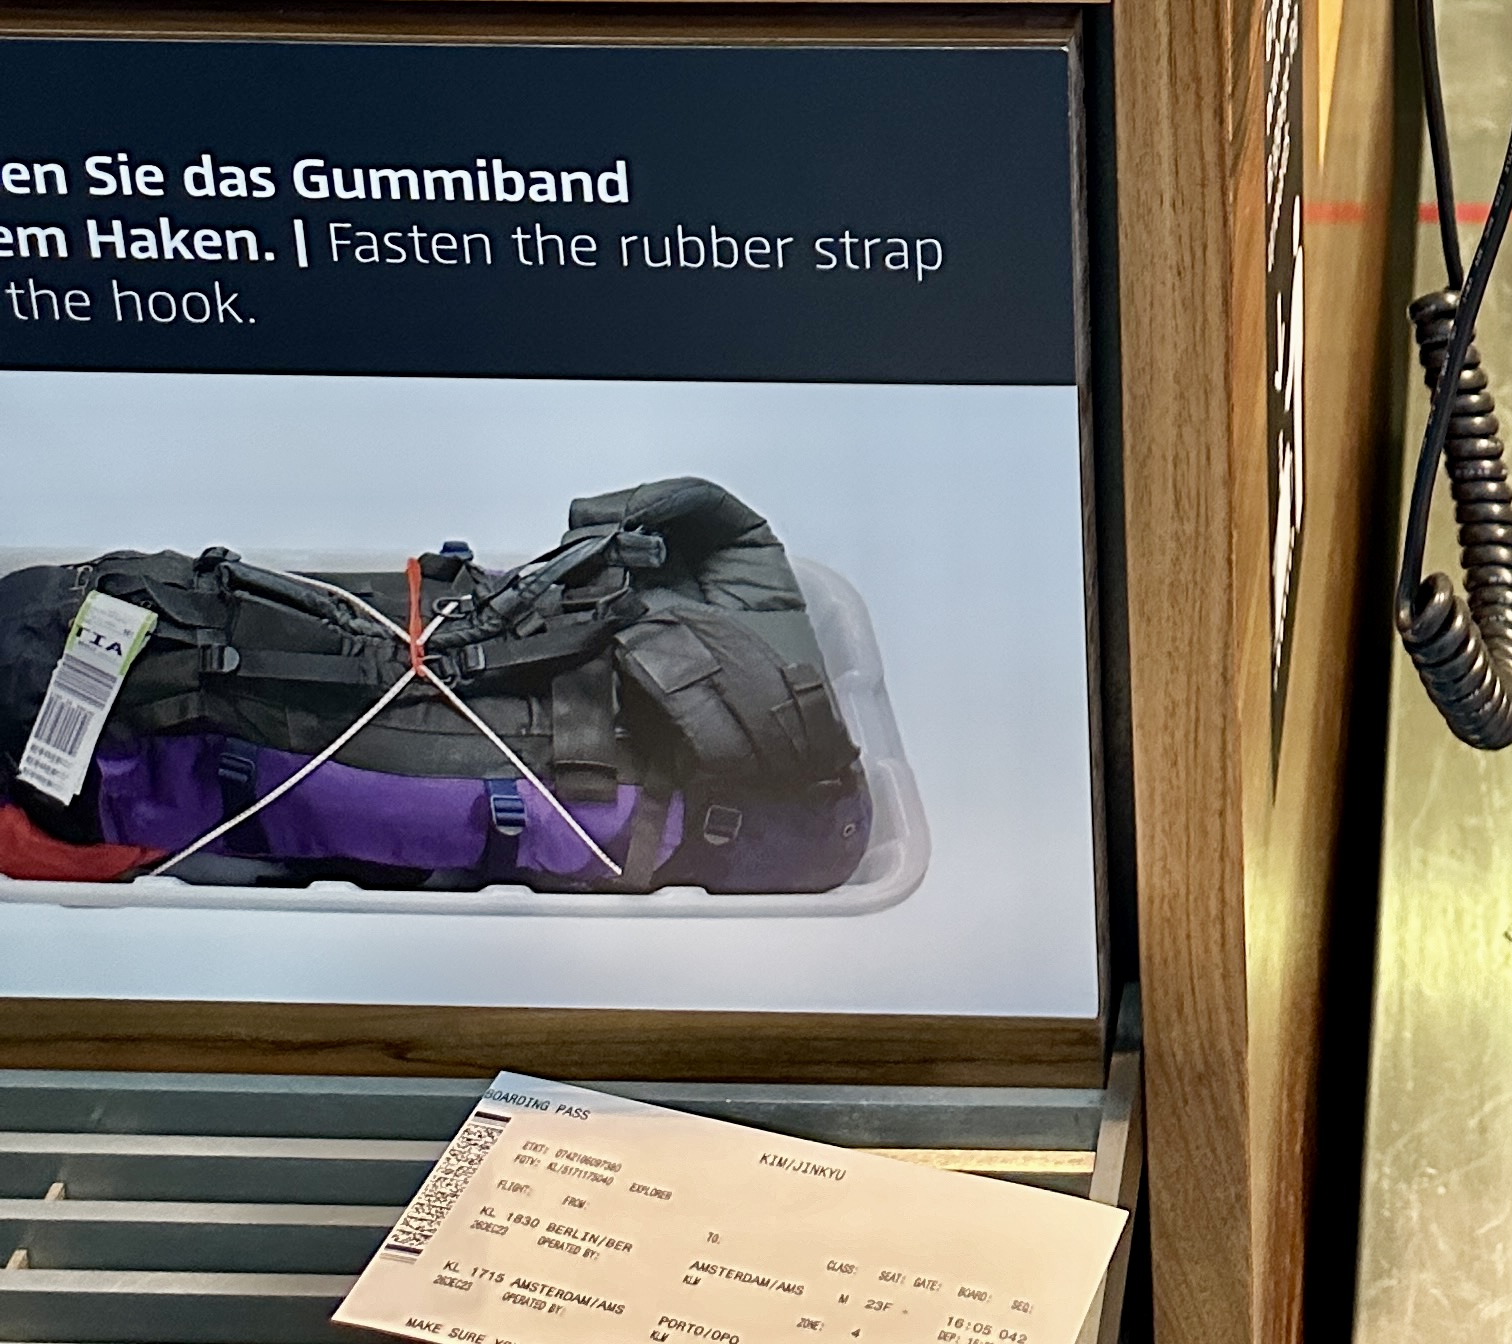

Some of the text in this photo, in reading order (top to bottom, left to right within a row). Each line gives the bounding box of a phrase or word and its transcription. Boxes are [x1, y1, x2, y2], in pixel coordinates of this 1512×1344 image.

[2, 153, 630, 205] en Sie das Gummiband
[86, 217, 275, 261] Haken.
[331, 221, 492, 267] Fasten
[513, 222, 597, 268] the
[620, 225, 793, 272] rubber
[813, 231, 943, 282] strap
[5, 278, 255, 324] the hook.
[483, 1089, 591, 1120] BOARDING PASS
[759, 1153, 847, 1181] KIM/JINKYU
[480, 1206, 496, 1218] KL
[507, 1212, 540, 1229] 1830
[545, 1222, 633, 1253] BERLIN/BER
[689, 1261, 805, 1296] AMSTERDAM/AMS
[838, 1294, 849, 1305] M
[947, 1316, 992, 1335] 16:05
[999, 1328, 1028, 1344] 042
[913, 1277, 942, 1292] GATE:
[443, 1260, 740, 1344] KL 1715 AMSTERDAM/AMS PORTO/OPO
[405, 1317, 487, 1344] MAKE SURE
